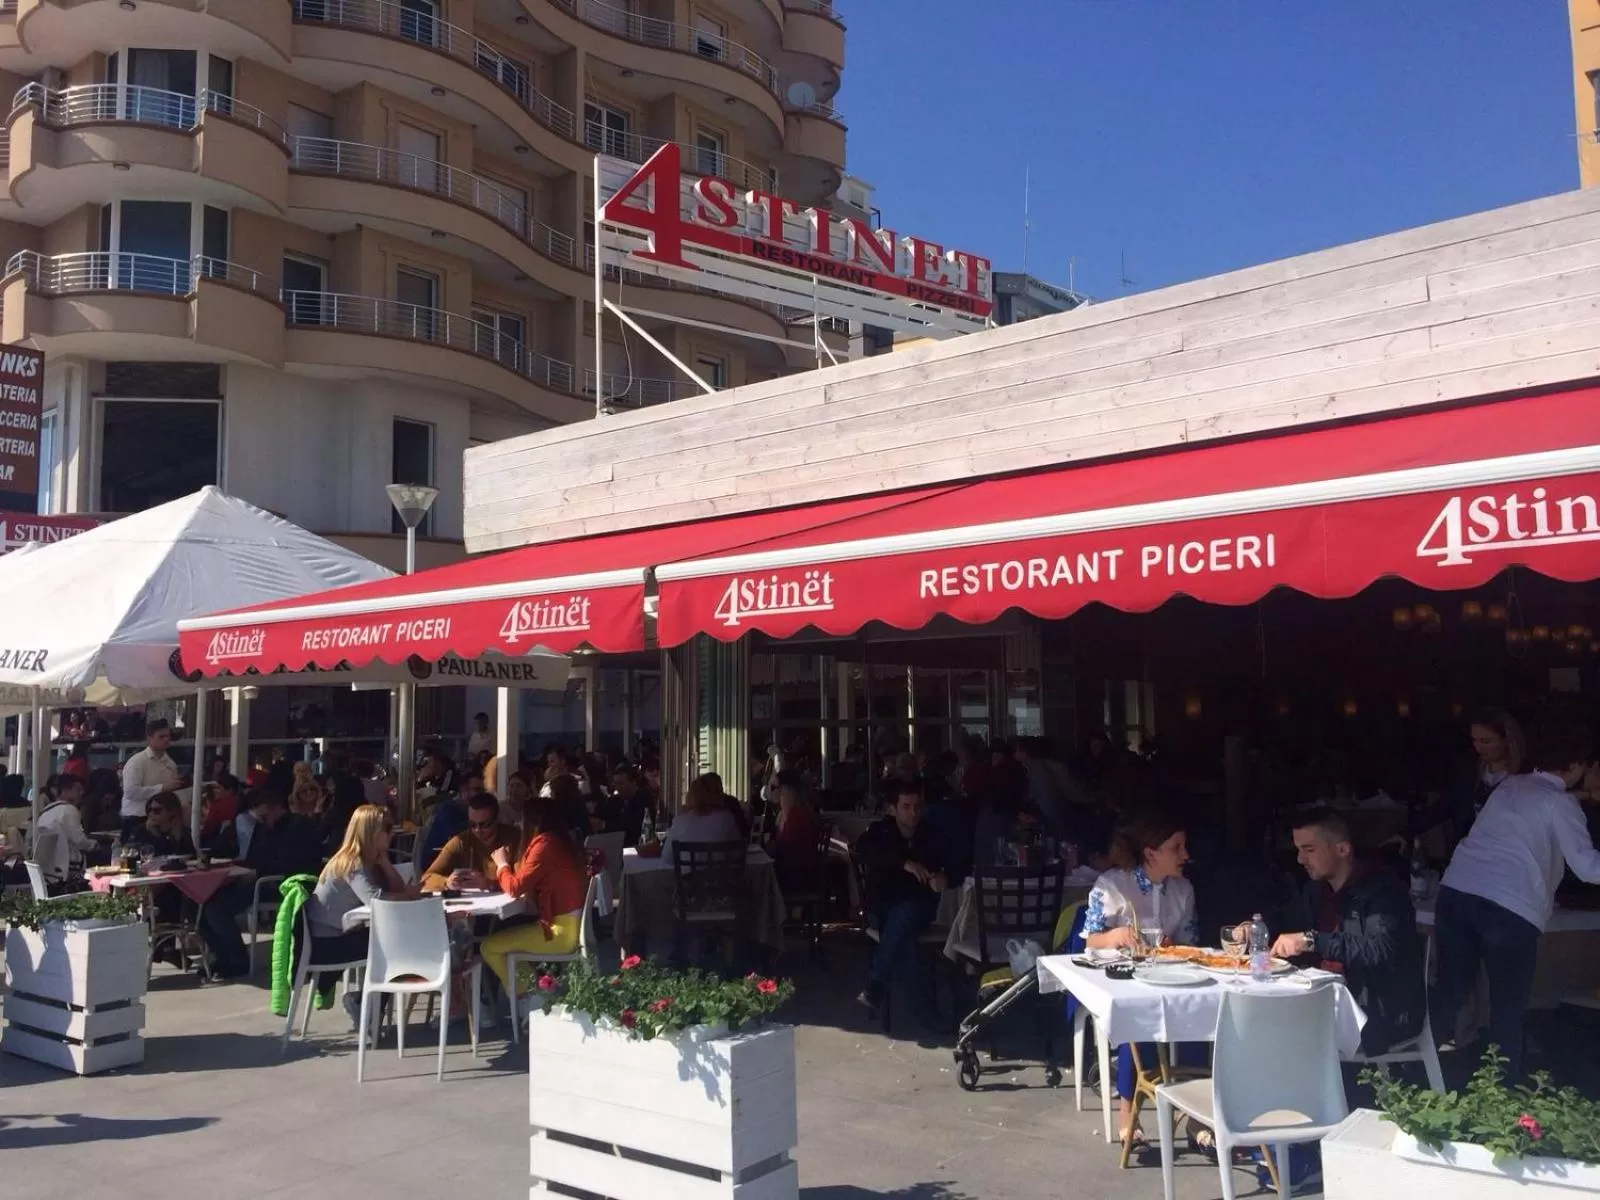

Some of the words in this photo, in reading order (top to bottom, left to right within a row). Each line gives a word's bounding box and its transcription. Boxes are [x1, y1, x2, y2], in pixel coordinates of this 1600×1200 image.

[752, 241, 877, 287] RESTORANT
[906, 281, 976, 315] PIZZERI
[0, 352, 39, 377] NKS
[919, 549, 1124, 599] RESTORANT
[1141, 533, 1276, 578] PICERI
[714, 570, 835, 626] 4Stinët
[301, 623, 393, 651] RESTORANT
[395, 617, 451, 643] PICERI
[499, 596, 591, 643] 4Stinët
[205, 629, 266, 665] 4Stinët
[437, 655, 538, 681] PAULANER
